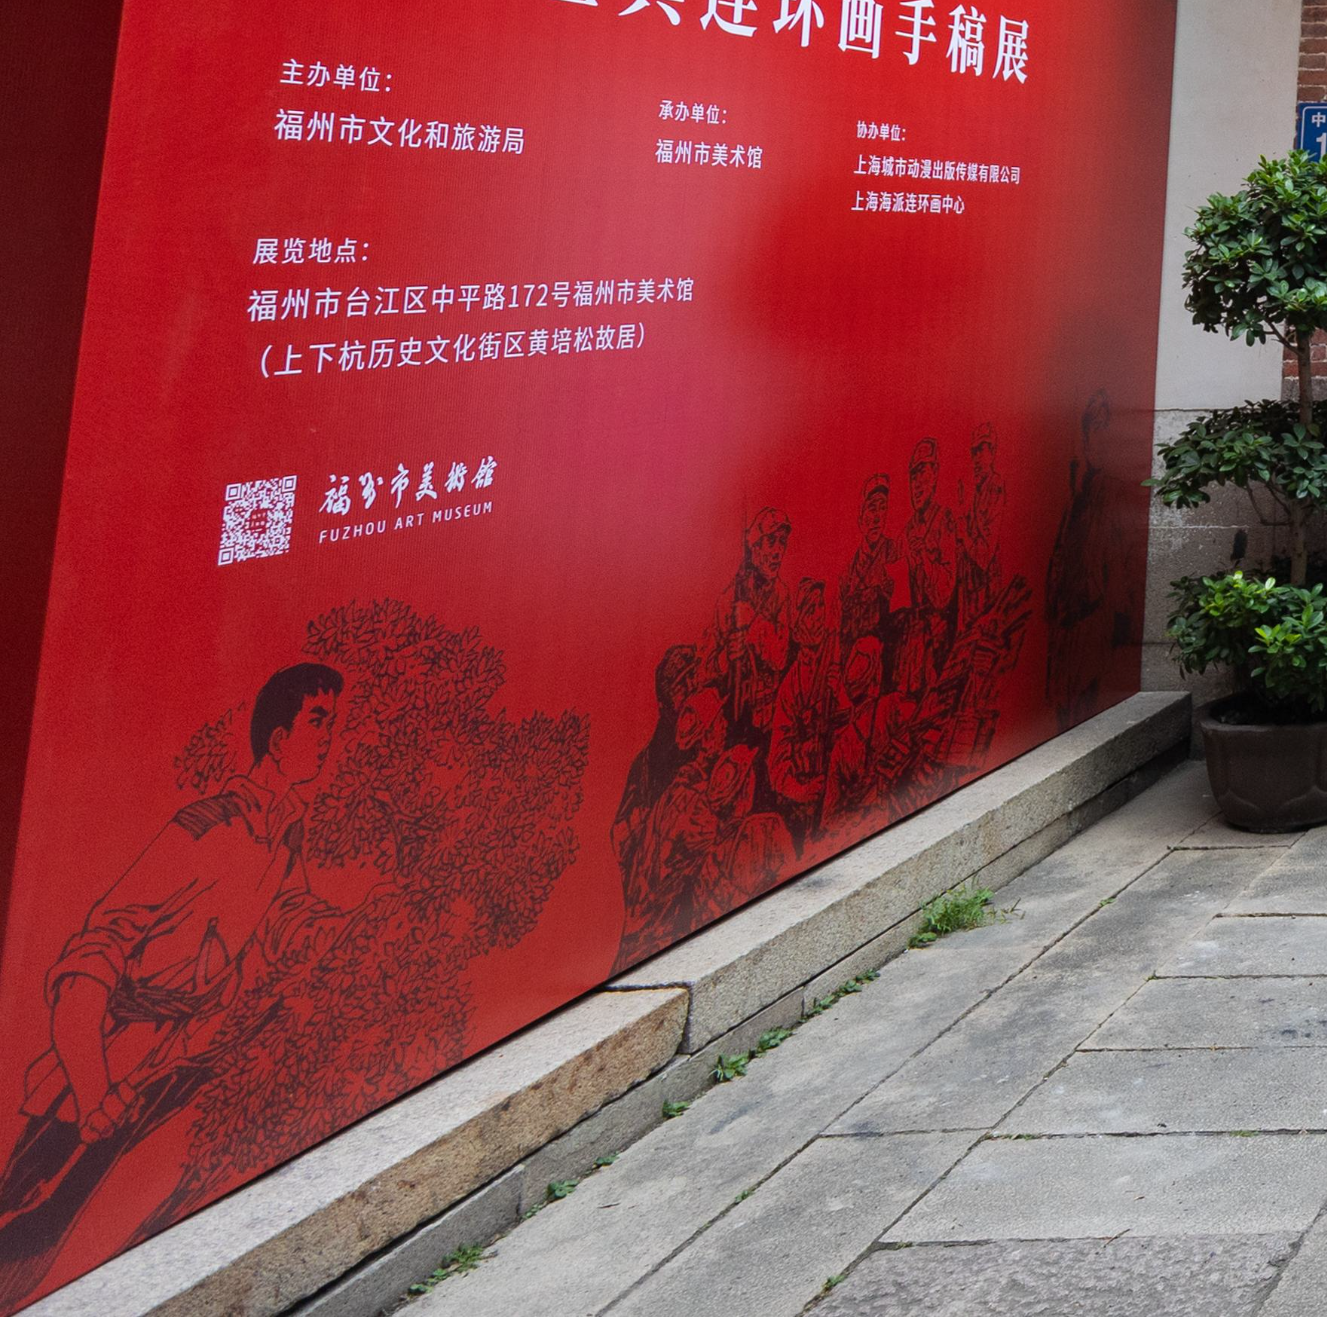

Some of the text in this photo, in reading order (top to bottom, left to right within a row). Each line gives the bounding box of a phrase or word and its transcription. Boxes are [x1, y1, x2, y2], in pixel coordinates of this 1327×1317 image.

[279, 58, 392, 92] 主办单位：
[658, 99, 727, 125] 承办单位：
[273, 108, 525, 155] 福州市文化和旅游局
[856, 120, 906, 142] 协办单位：
[654, 138, 763, 169] 福州市美术馆
[853, 154, 1021, 185] 上海城市动漫出版传媒有限公司
[850, 190, 965, 215] 上海海派连环画中心
[252, 237, 369, 265] 展览地点：
[246, 276, 694, 323] 福州市台江区中平路172号福州市美术馆
[260, 321, 646, 379] （上下杭历史文化街区黄培松故居）
[318, 501, 492, 544] FUZHOU ART MUSEUM
